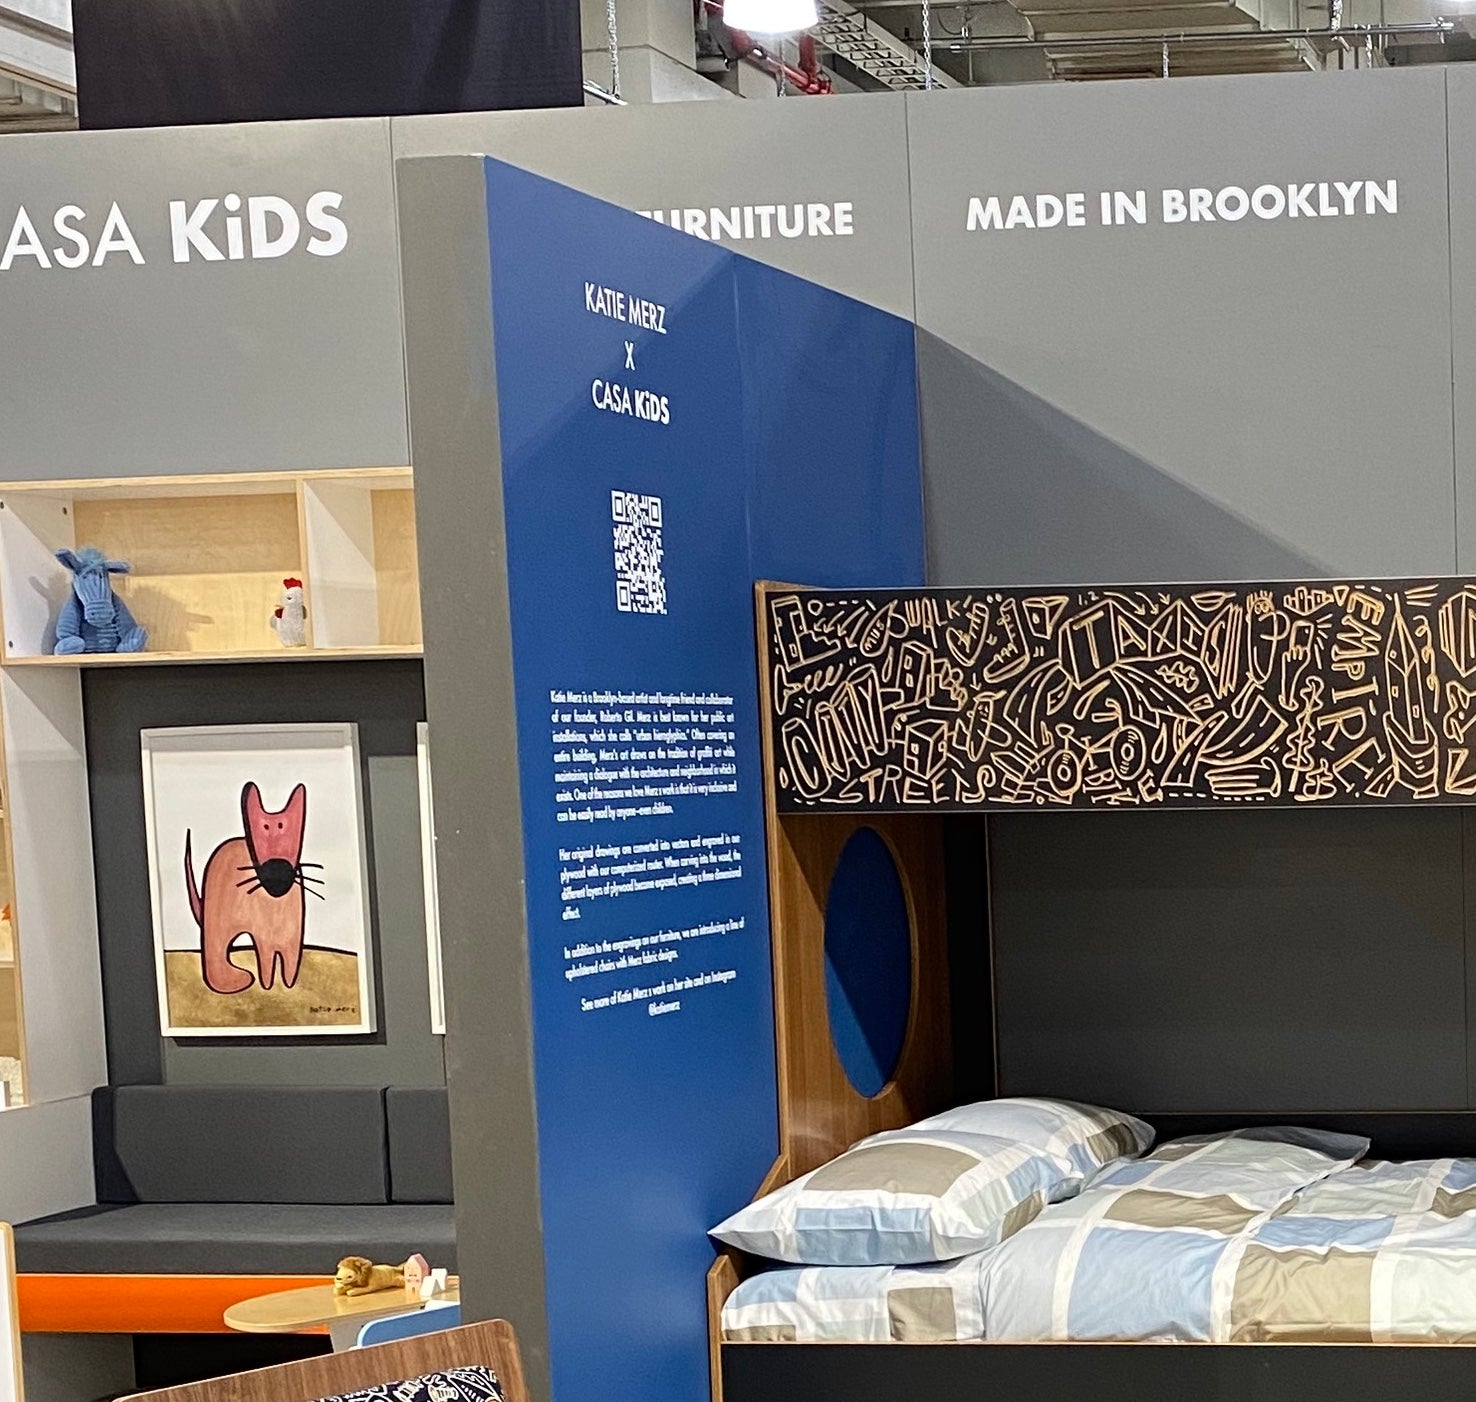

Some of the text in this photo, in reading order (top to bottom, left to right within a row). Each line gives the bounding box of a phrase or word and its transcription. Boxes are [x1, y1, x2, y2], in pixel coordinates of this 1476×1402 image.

[169, 191, 348, 263] KiDS
[966, 179, 1398, 231] MADE IN BROOKLYN
[585, 281, 667, 334] KATIE MERZ
[624, 340, 636, 371] X
[592, 379, 633, 416] CASA
[904, 597, 961, 649] WALK
